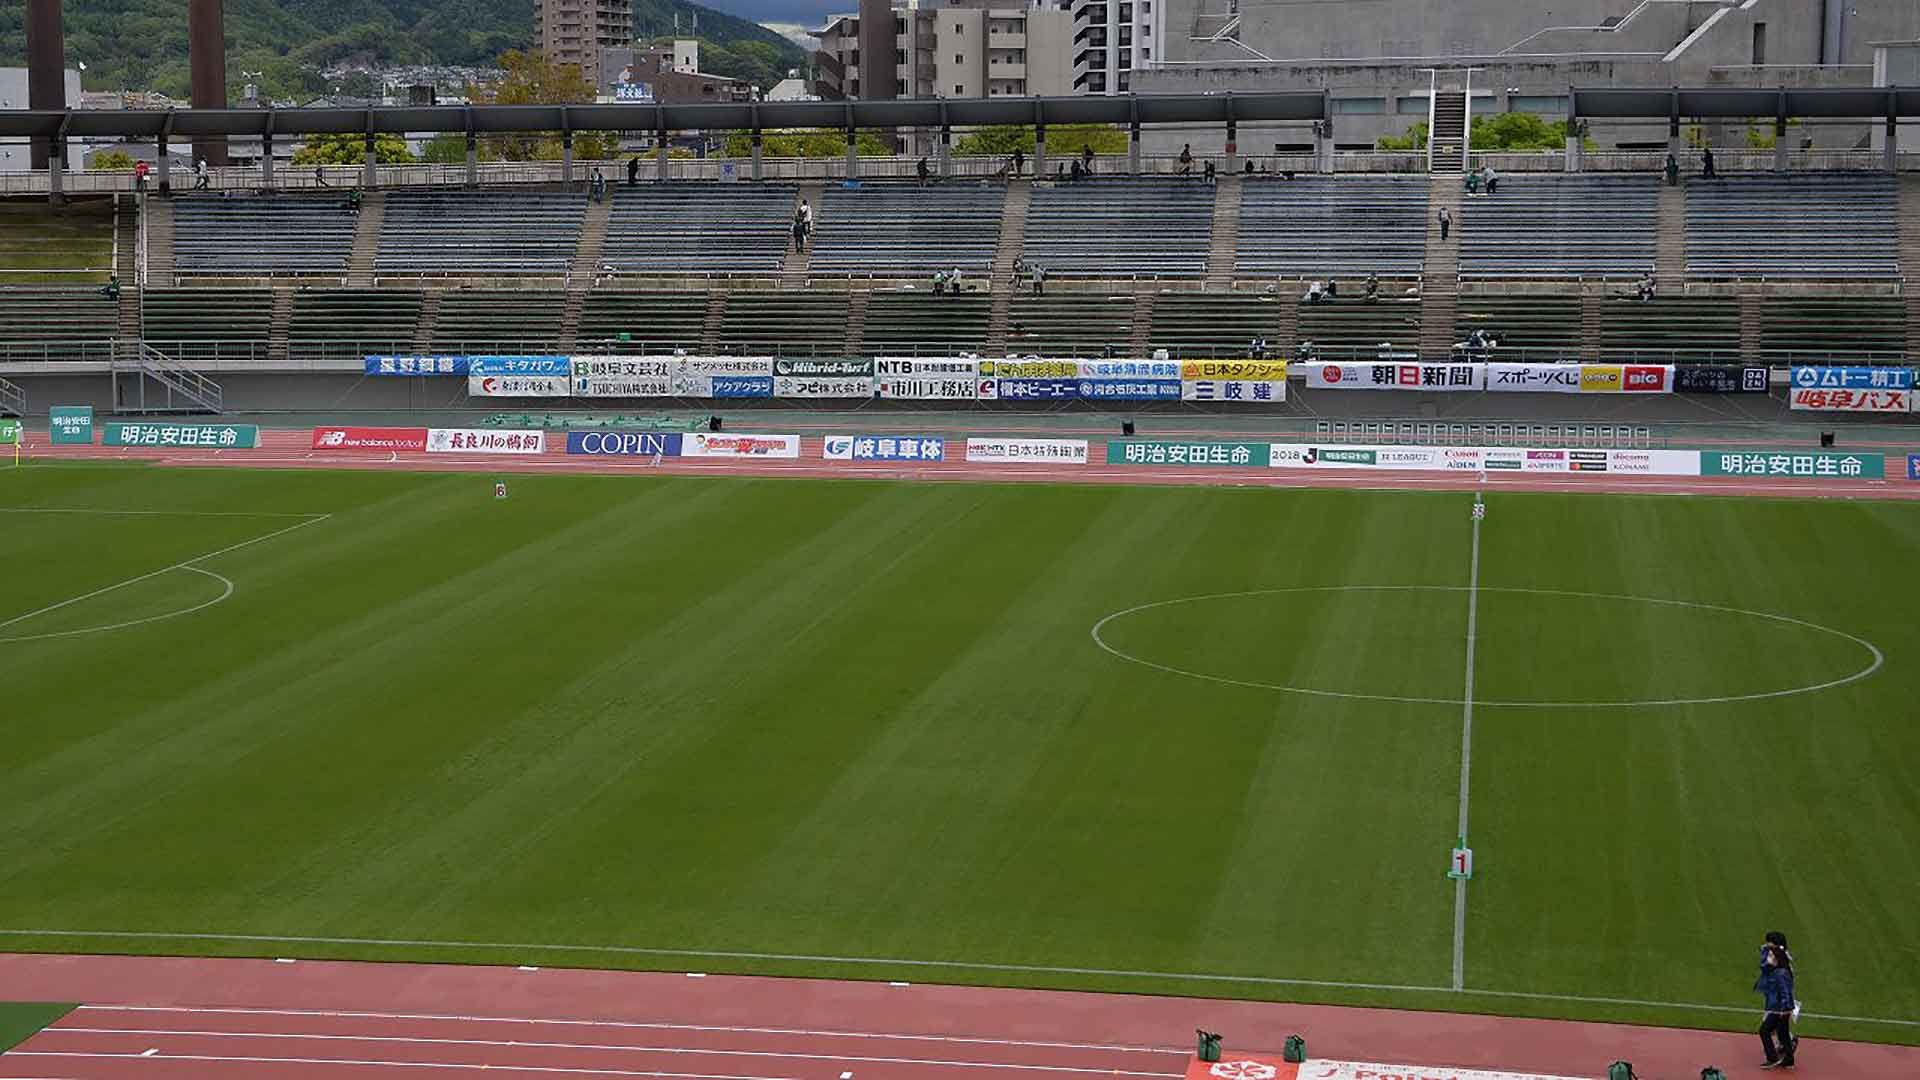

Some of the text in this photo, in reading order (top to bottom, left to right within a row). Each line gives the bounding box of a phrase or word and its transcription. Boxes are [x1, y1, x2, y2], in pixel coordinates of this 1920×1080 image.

[878, 361, 912, 373] NTB
[1203, 363, 1284, 376] 日本タクシー
[1371, 365, 1474, 386] 朝日新聞
[1497, 368, 1578, 385] スポーツくじ
[1820, 368, 1905, 387] ムトー精工
[892, 381, 973, 397] 市川工務店
[1796, 390, 1904, 409] 岐阜バス
[121, 425, 238, 446] 明治安田生命
[582, 432, 666, 454] COPIN
[854, 438, 941, 460] 岐阜車体
[1125, 444, 1251, 464] 明治安田生命
[1272, 450, 1299, 460] 2018
[1721, 454, 1862, 475] 明治安田生命
[1455, 854, 1465, 874] 1
